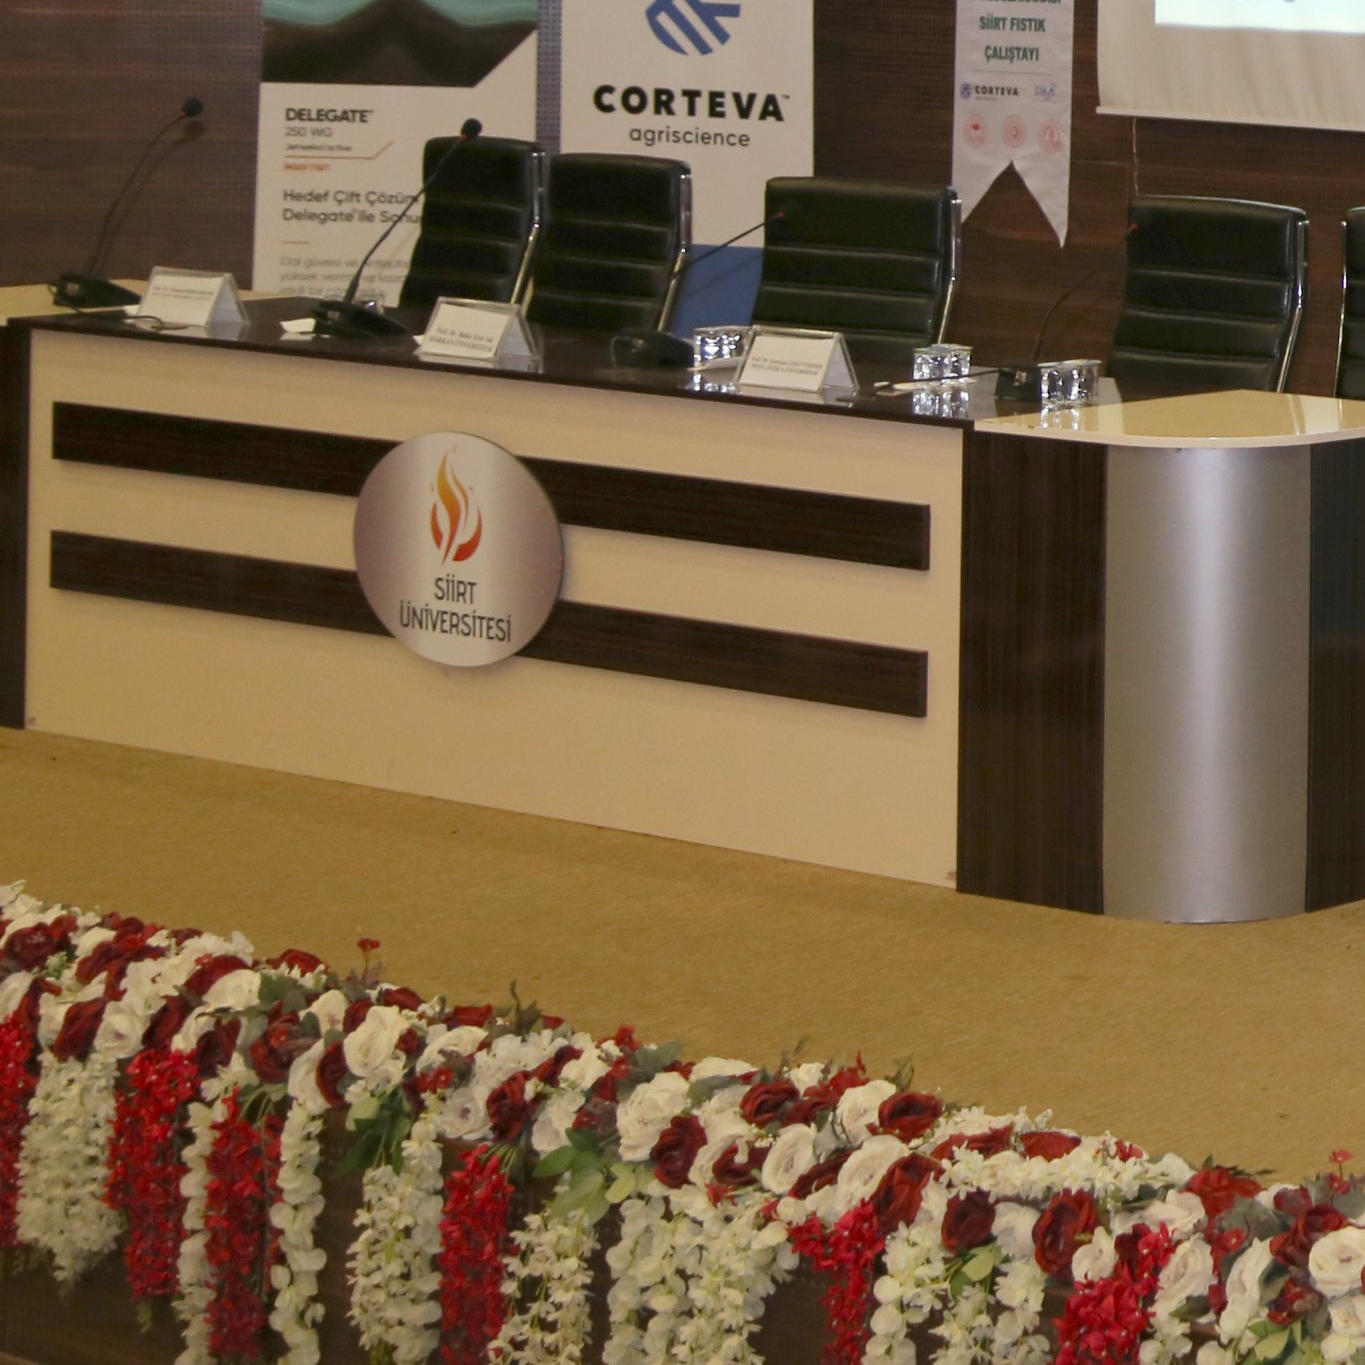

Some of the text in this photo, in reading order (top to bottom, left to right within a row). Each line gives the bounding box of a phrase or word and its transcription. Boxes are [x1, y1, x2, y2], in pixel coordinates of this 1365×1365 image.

[1010, 17, 1045, 33] FISTIK
[984, 45, 1039, 64] ÇALIŞTAYI
[975, 85, 1019, 97] CORTEVA
[629, 127, 751, 148] agriscience
[283, 189, 329, 203] Hedef
[333, 189, 360, 206] Çift
[435, 574, 477, 605] SİİRT
[400, 600, 511, 643] ÜNİVERSİTESİ
